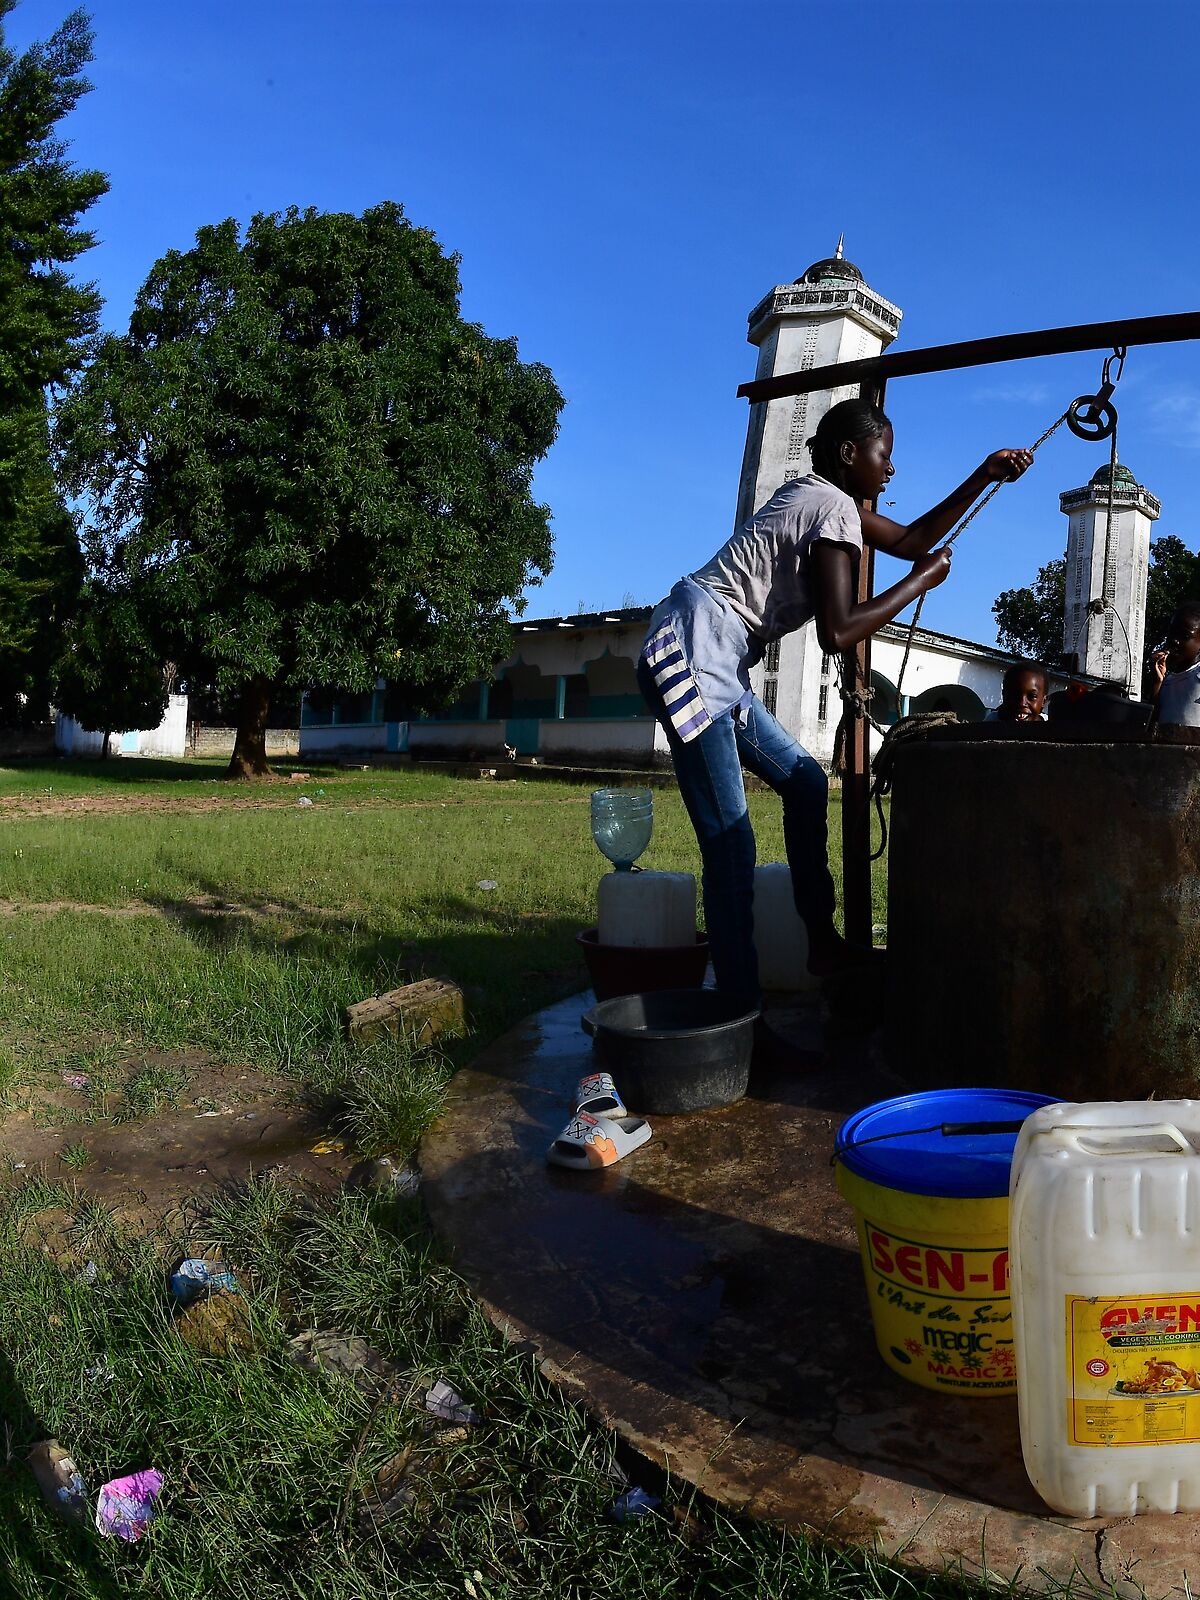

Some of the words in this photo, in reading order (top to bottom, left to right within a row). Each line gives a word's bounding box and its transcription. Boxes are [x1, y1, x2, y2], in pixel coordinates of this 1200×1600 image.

[922, 1325, 993, 1357] magic
[1164, 1332, 1200, 1341] COOKING
[927, 1360, 997, 1379] MAGIC
[1002, 1366, 1017, 1378] 2
